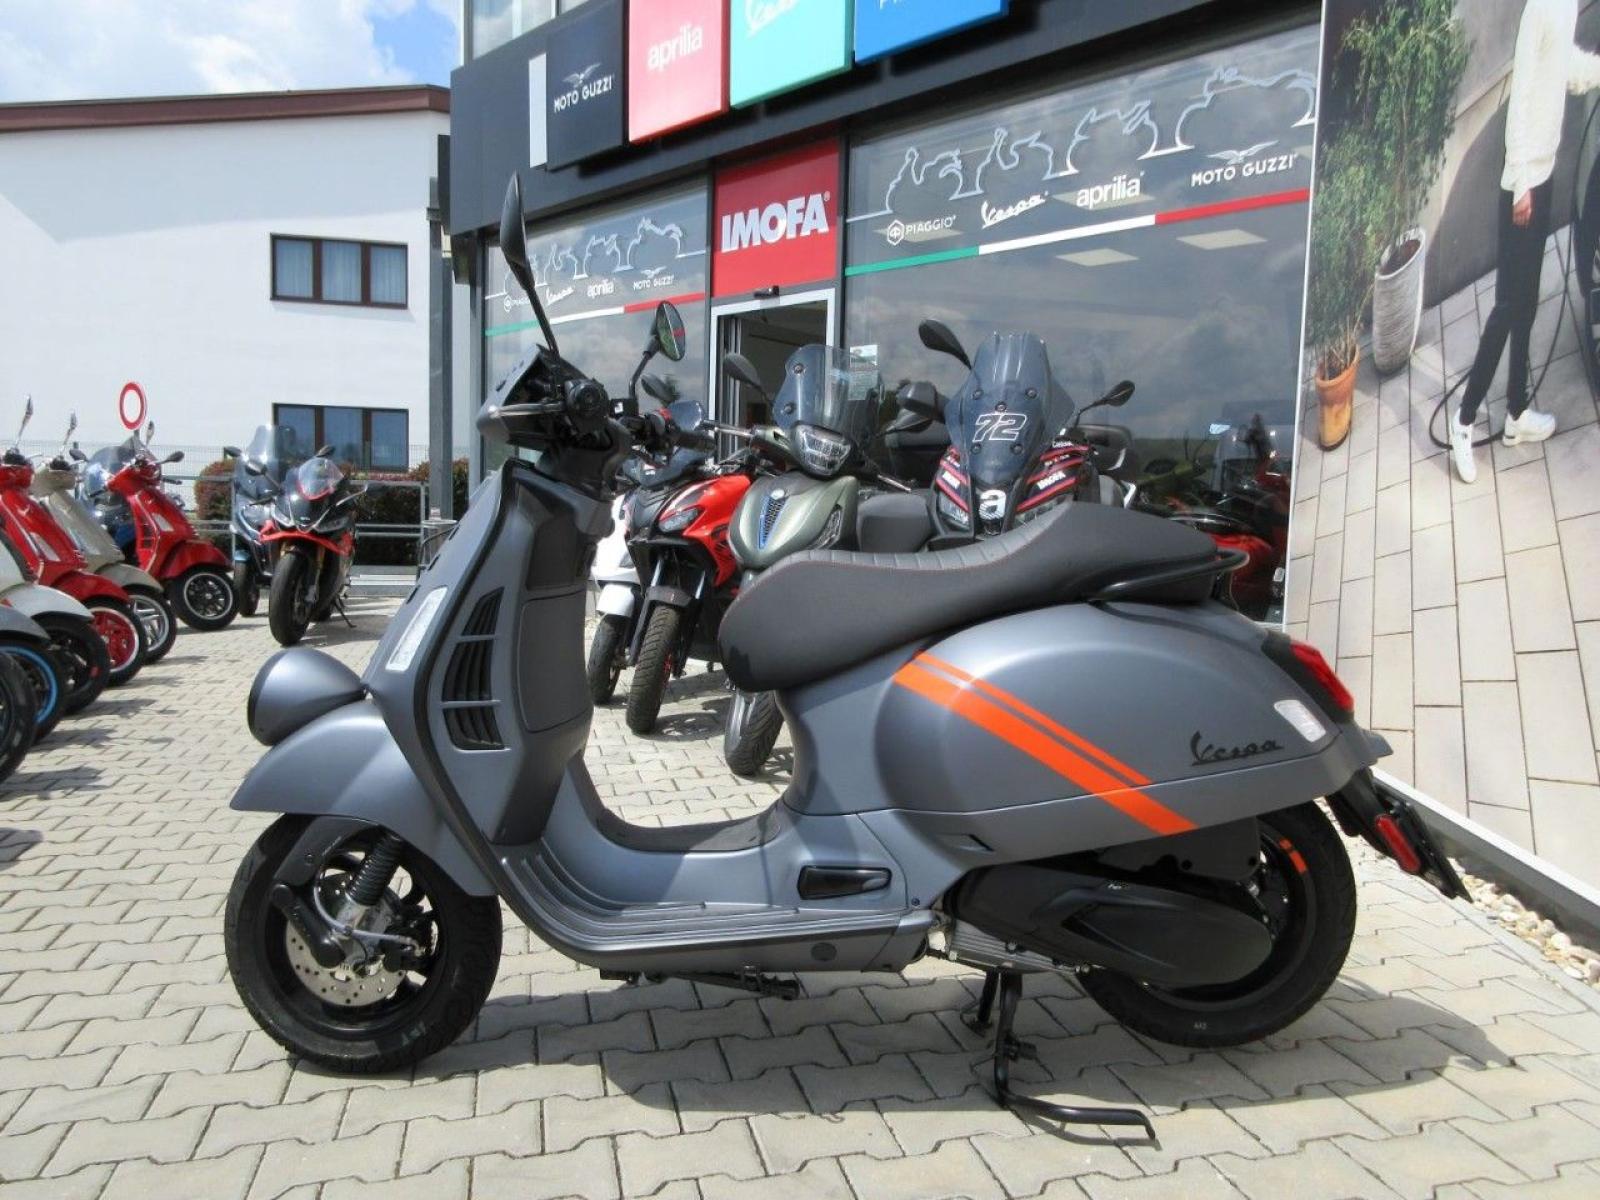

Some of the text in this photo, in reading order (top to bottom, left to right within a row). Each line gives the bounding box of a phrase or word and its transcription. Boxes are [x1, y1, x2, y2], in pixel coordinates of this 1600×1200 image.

[647, 22, 703, 72] aprilia
[554, 75, 612, 113] MOTO GUZZI
[1191, 155, 1294, 187] MOTO GUZZI
[1076, 174, 1141, 209] aprilia
[905, 217, 954, 235] PIAGGIO
[981, 195, 1046, 229] Vespa
[633, 275, 674, 291] MOTO GUZZI
[972, 413, 1027, 443] 72
[1190, 731, 1284, 766] Vespa
